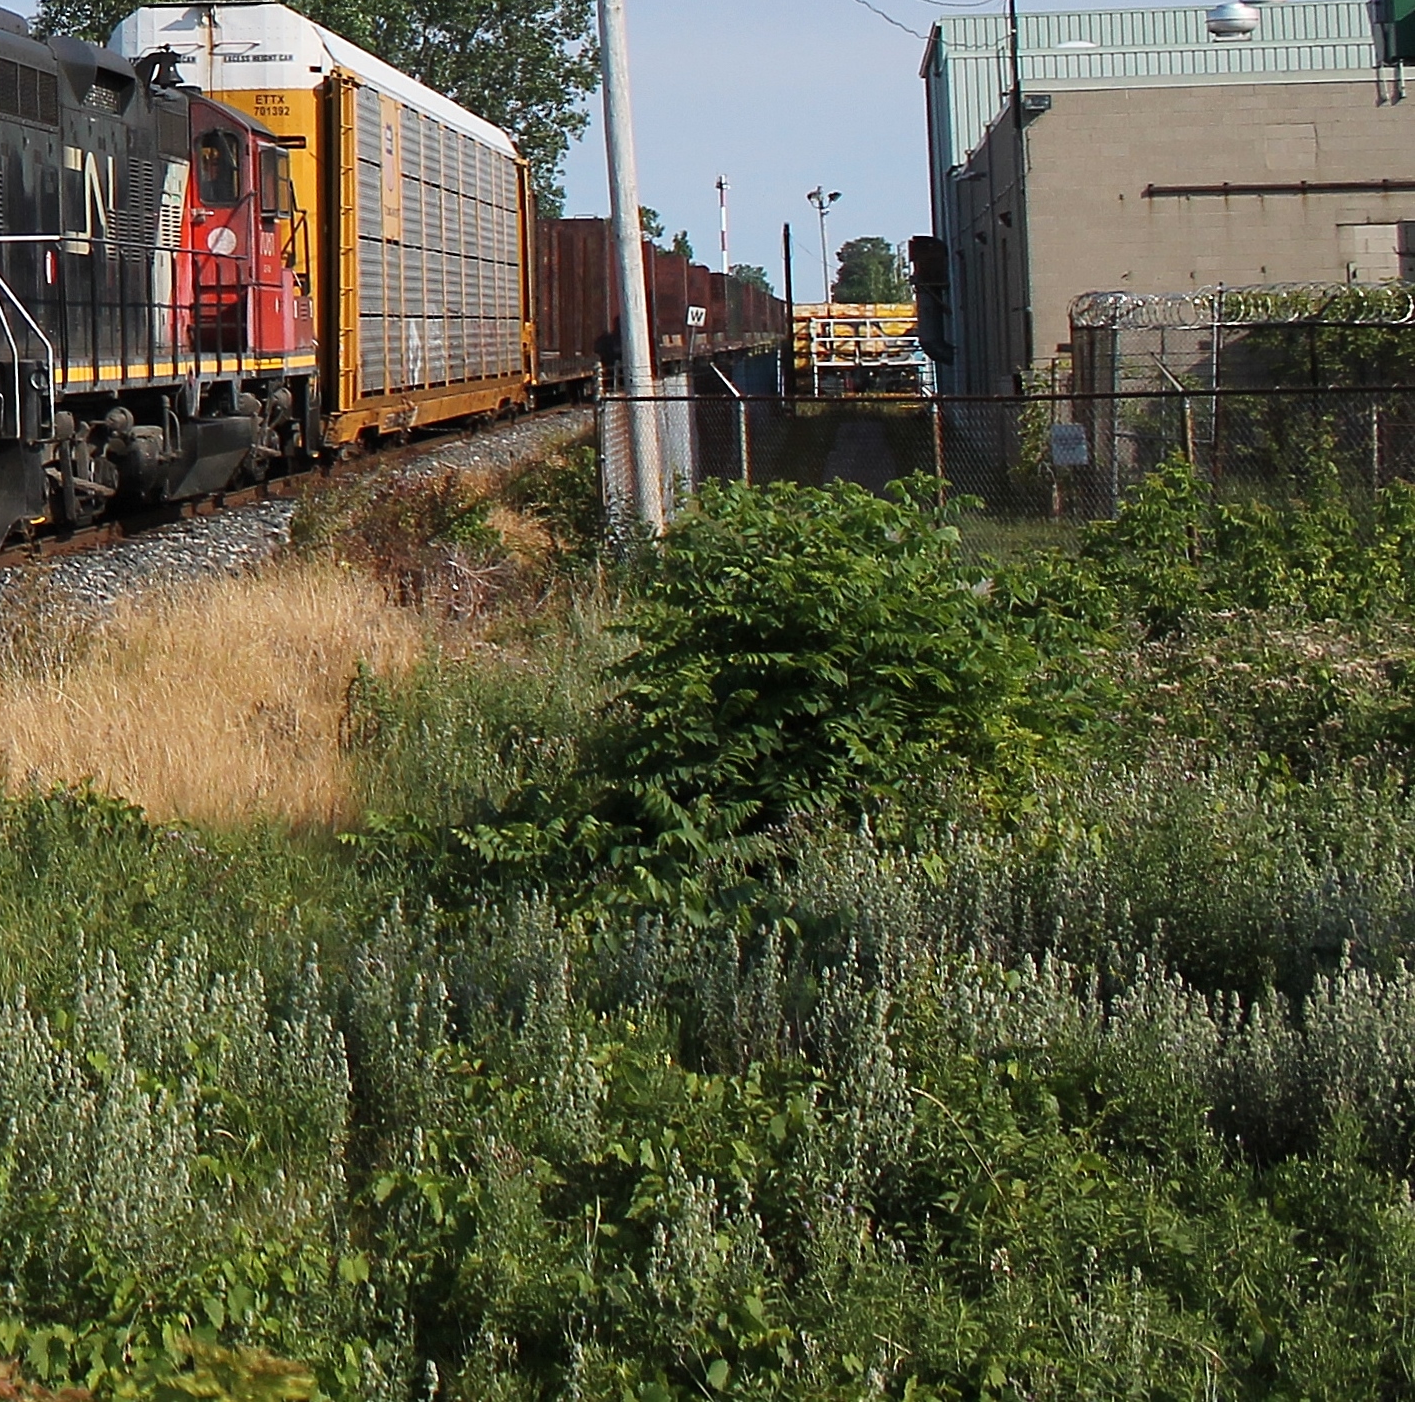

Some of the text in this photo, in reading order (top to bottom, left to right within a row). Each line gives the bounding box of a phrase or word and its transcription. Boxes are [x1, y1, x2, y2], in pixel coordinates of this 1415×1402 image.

[223, 54, 293, 63] EXCESS HEIGHT CAR
[255, 95, 285, 104] ETTX
[254, 106, 290, 116] 701392
[690, 309, 703, 323] W
